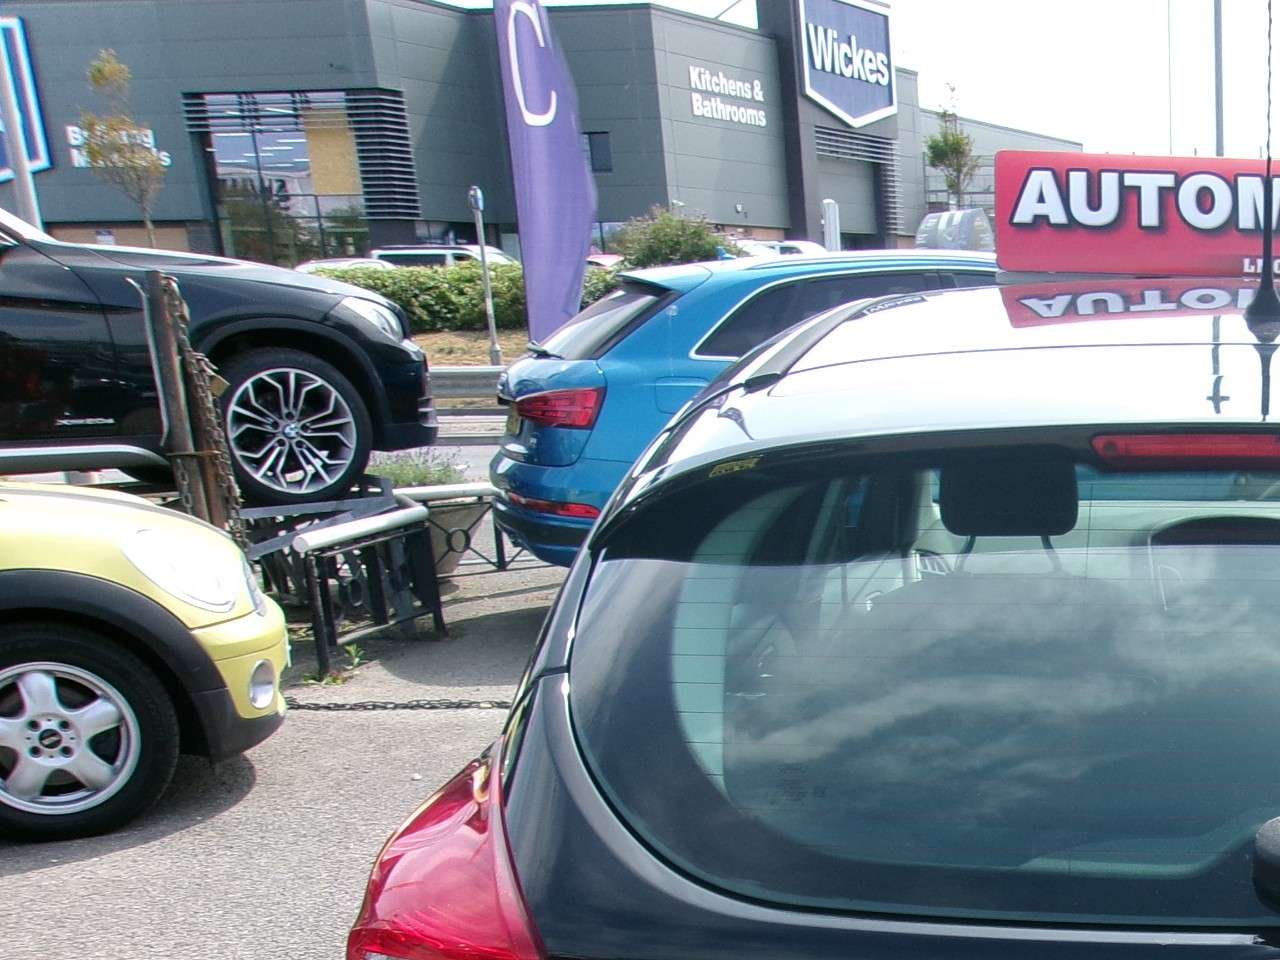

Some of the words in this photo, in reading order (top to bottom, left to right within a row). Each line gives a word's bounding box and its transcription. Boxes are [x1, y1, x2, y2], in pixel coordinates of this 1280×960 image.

[808, 23, 889, 86] Wickes
[689, 65, 752, 99] Kitchens
[753, 79, 765, 101] &
[692, 92, 767, 127] Bathrooms
